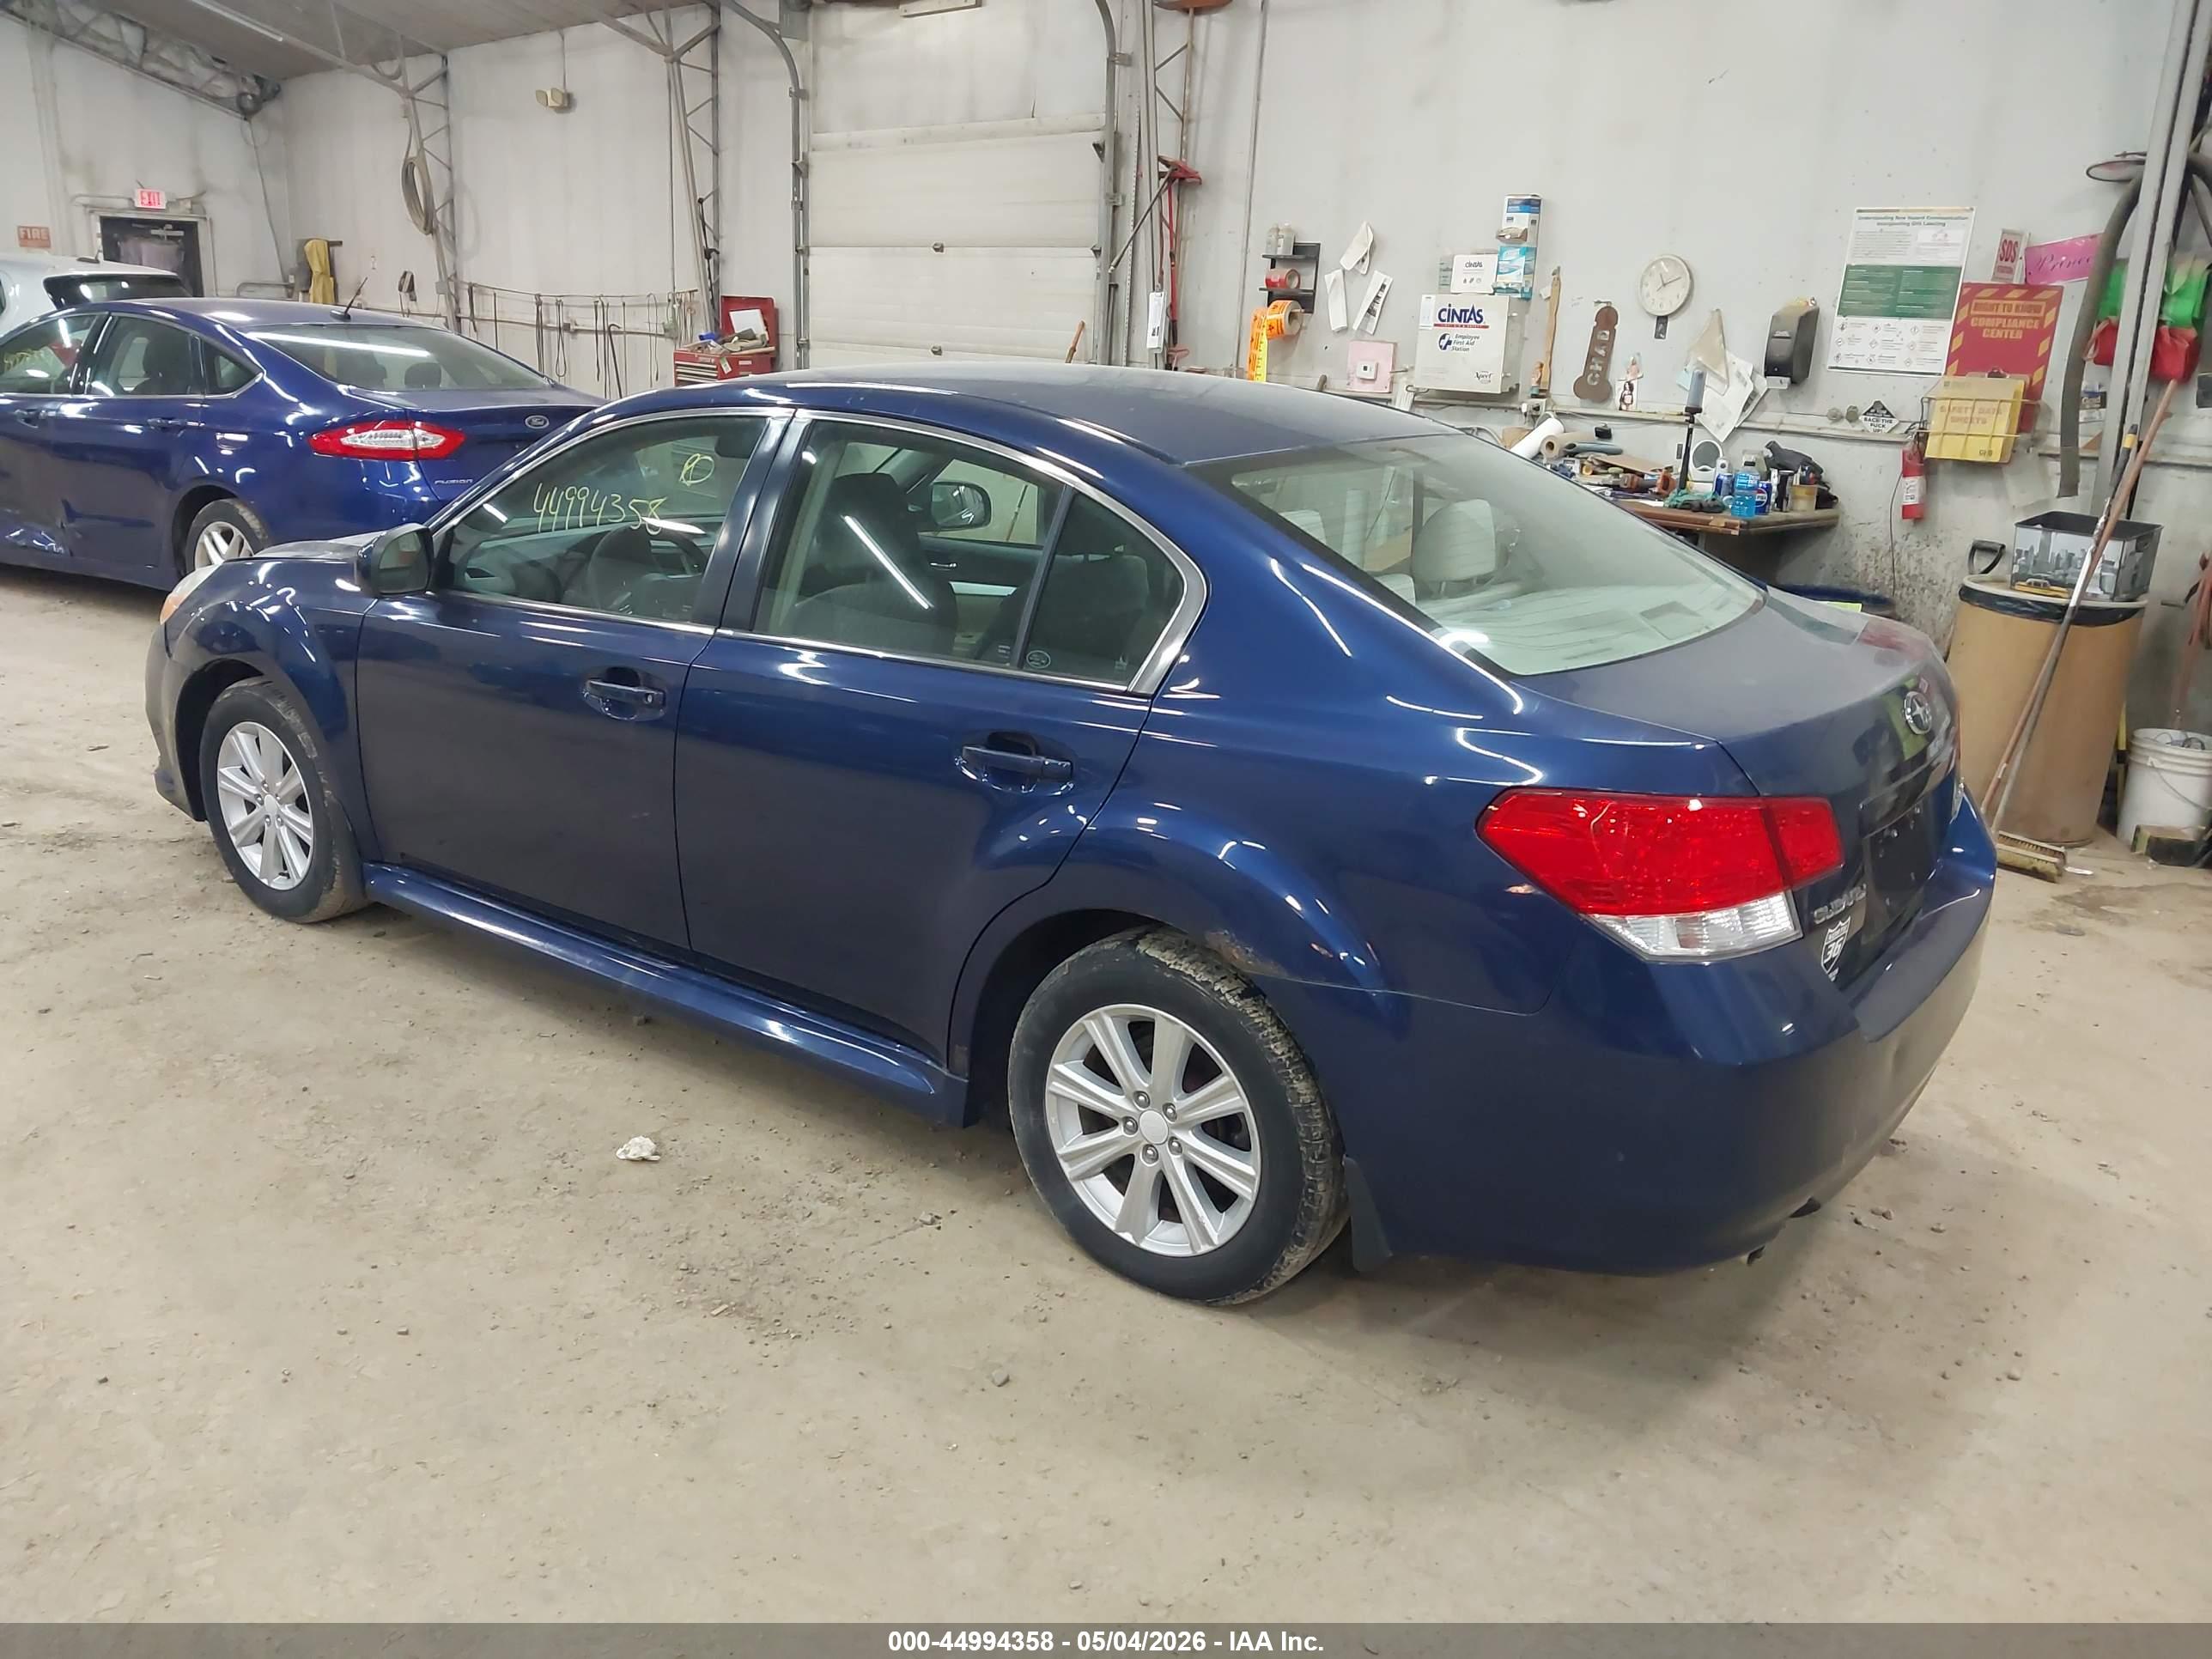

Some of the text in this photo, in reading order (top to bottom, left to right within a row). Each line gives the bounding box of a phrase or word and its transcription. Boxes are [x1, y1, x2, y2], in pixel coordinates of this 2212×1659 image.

[20, 228, 49, 240] FIRE
[1999, 239, 2019, 263] SDS
[2002, 303, 2013, 313] TO
[1971, 316, 2041, 330] COMPLIANCE
[1455, 333, 1480, 343] Employee
[1983, 328, 2023, 339] CENTER
[1586, 330, 1611, 386] CHAD
[533, 483, 668, 535] 44994358
[1823, 936, 1844, 963] 36
